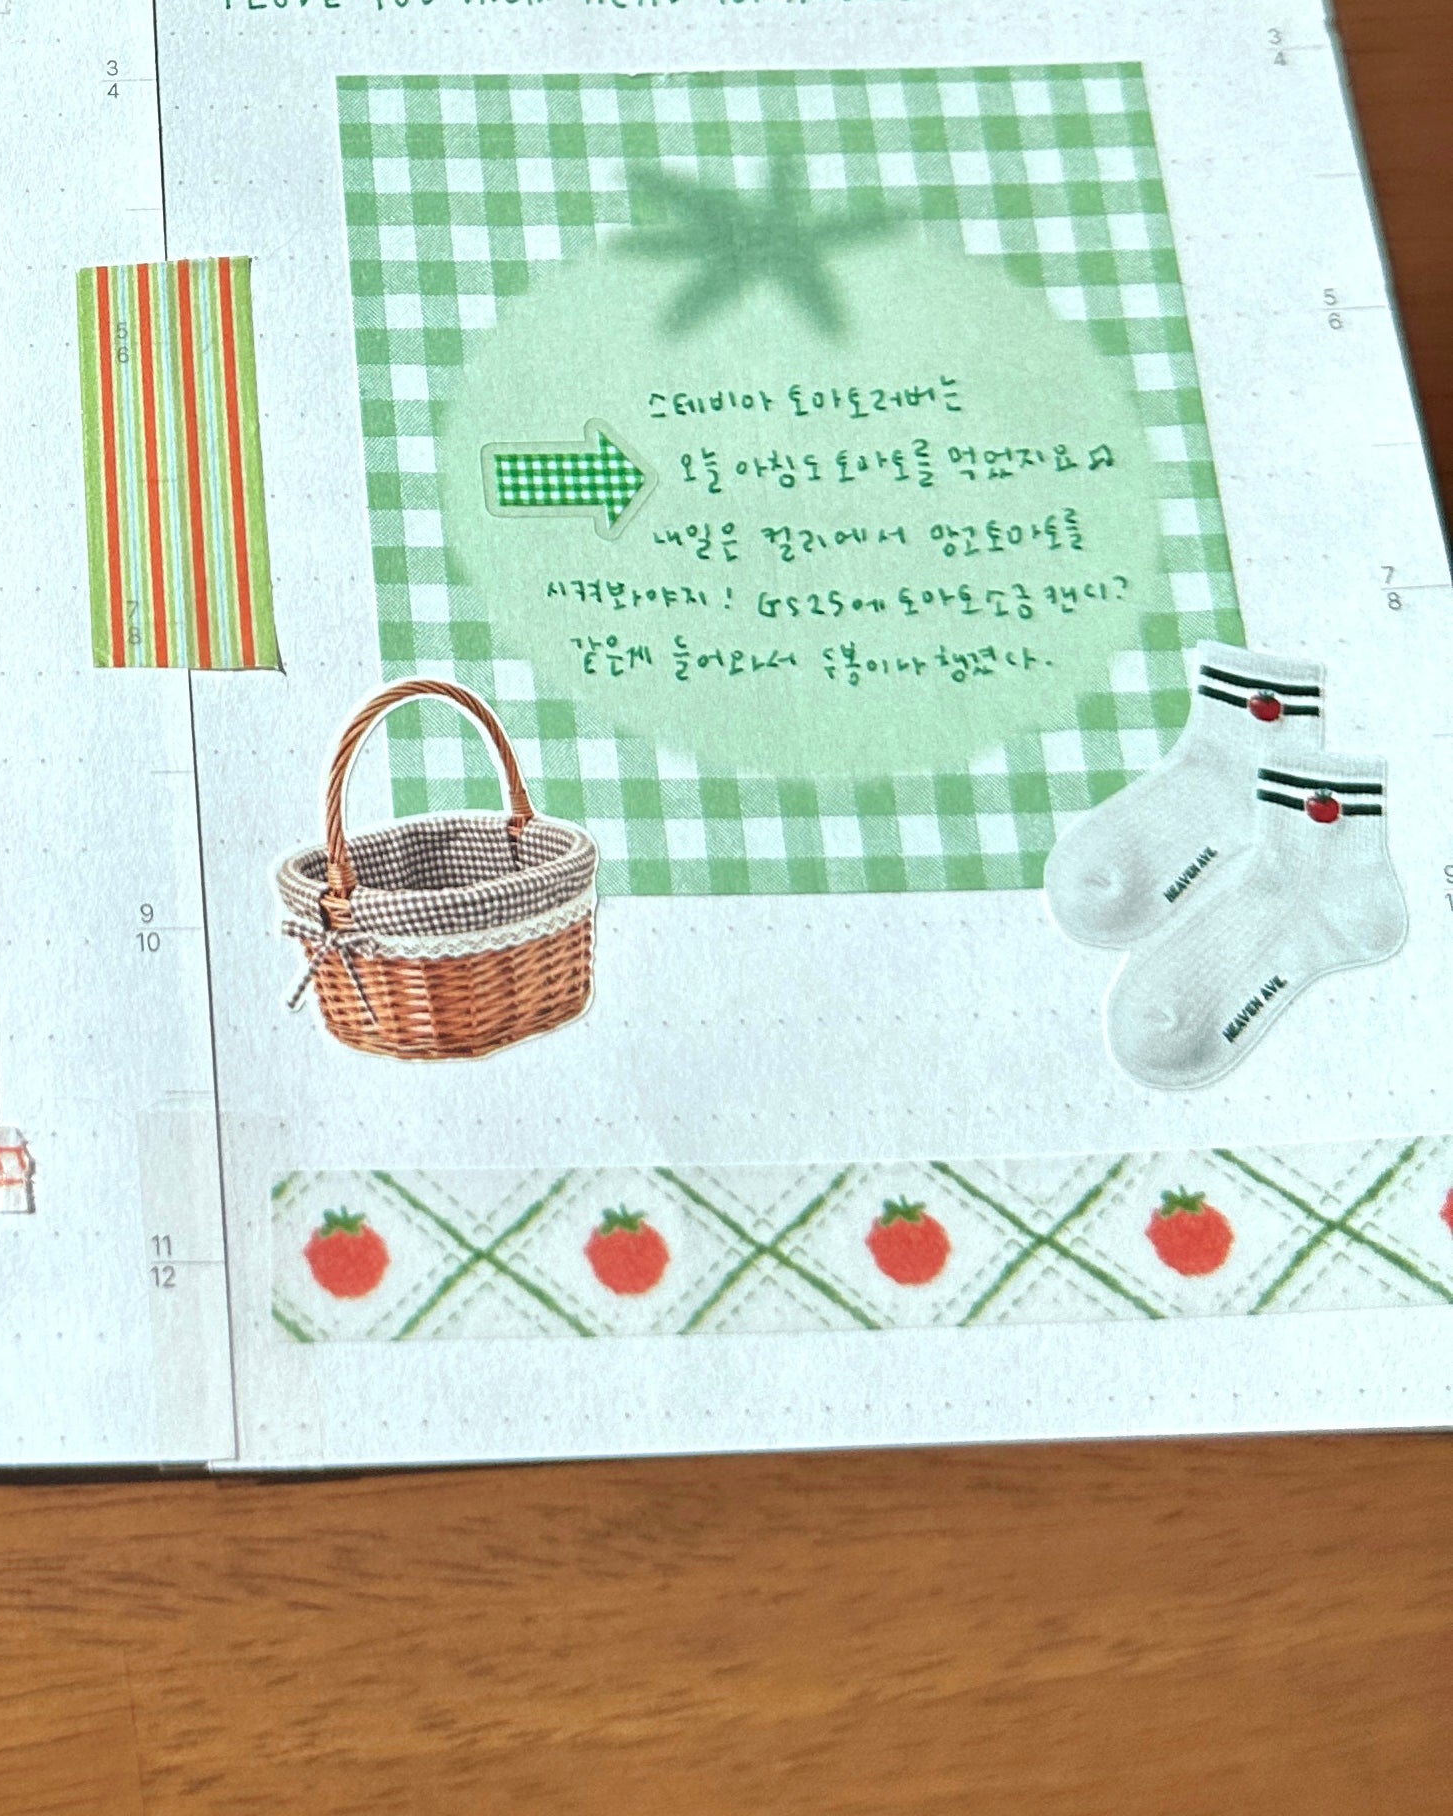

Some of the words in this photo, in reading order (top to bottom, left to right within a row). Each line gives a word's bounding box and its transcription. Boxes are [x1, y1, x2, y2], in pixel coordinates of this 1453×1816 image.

[1269, 28, 1283, 45] 3
[106, 60, 119, 76] 3
[107, 83, 120, 100] 4
[1324, 289, 1336, 306] 5
[681, 447, 722, 495] 오늘
[653, 521, 738, 562] 내일은
[1382, 566, 1395, 584] 7
[1388, 593, 1402, 611] 8
[140, 904, 155, 924] 9
[136, 933, 161, 954] 10
[151, 1236, 174, 1257] 11
[151, 1265, 176, 1289] 12
